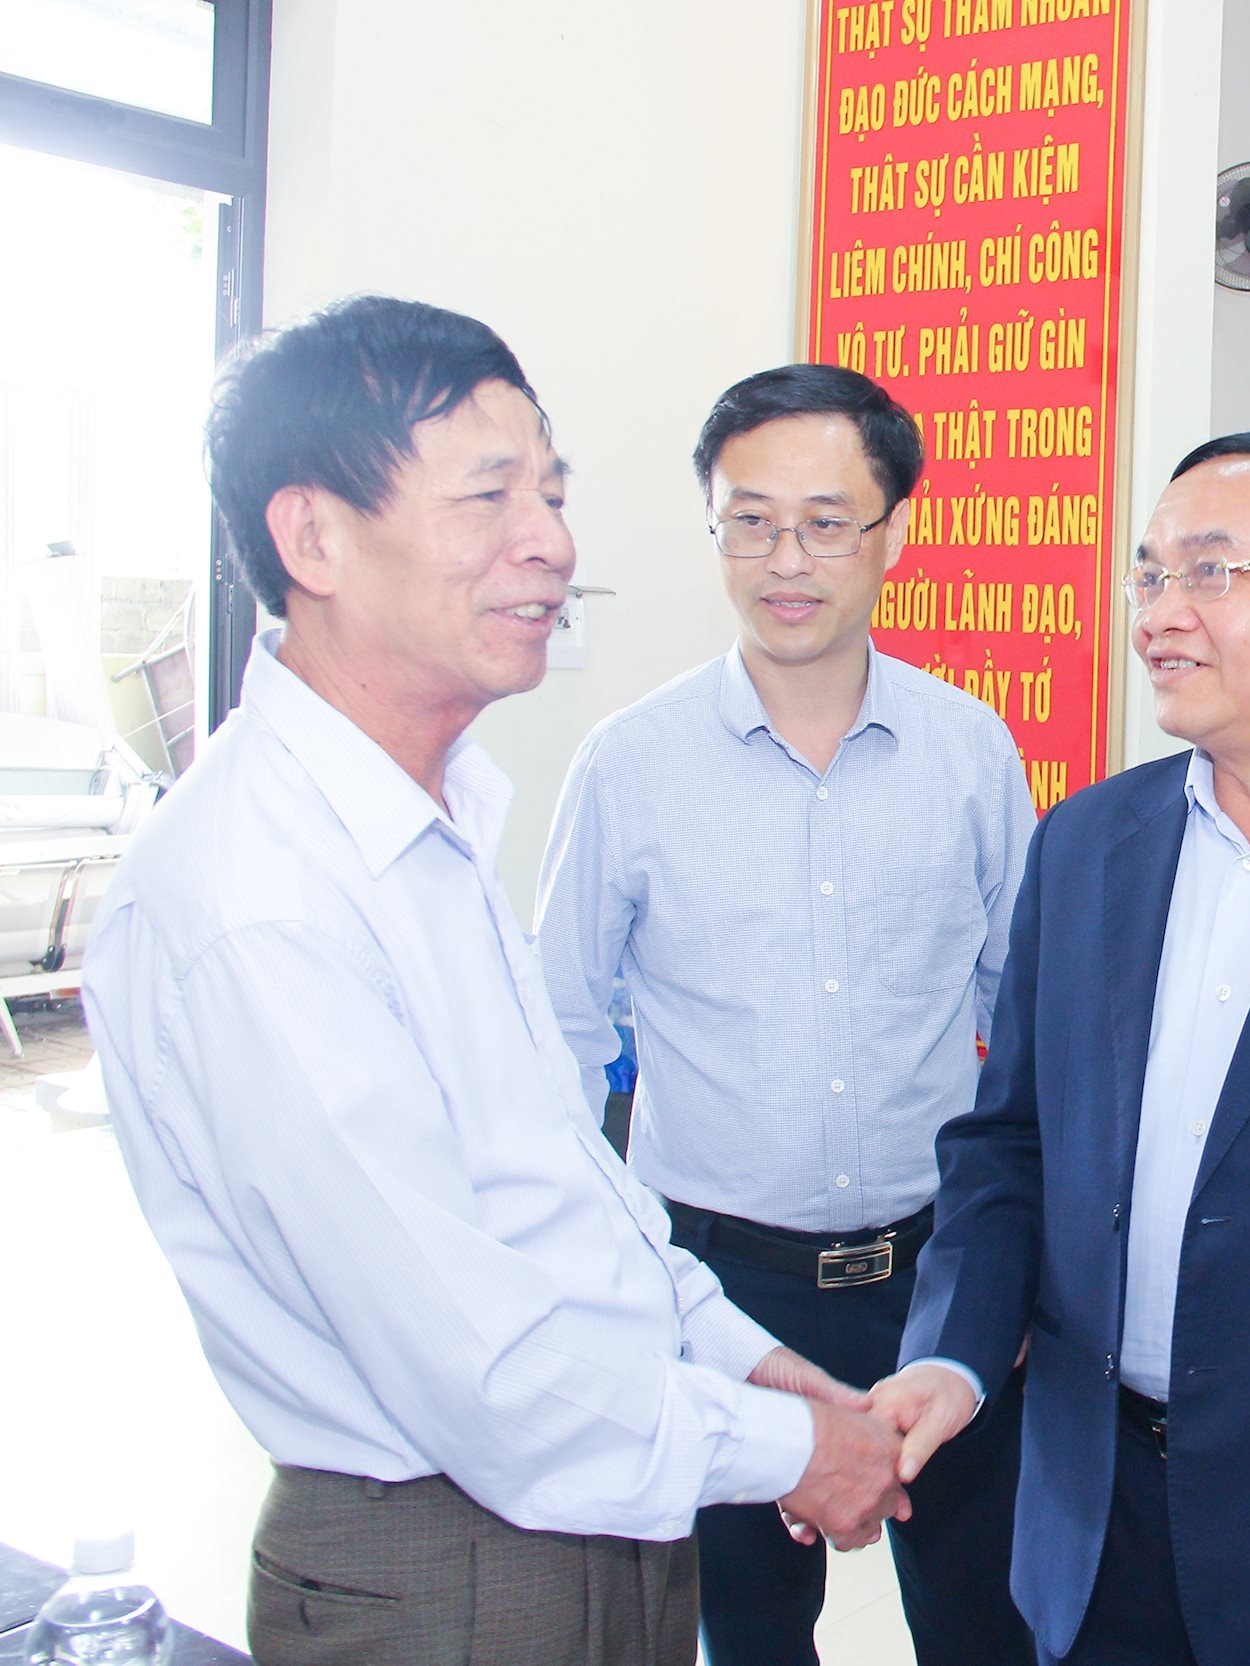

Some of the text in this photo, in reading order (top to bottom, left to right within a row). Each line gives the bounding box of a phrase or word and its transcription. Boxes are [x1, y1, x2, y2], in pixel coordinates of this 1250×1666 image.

[839, 53, 1105, 143] ĐẠO ĐỨC CÁCH MẠNG,
[914, 152, 950, 217] SỰ
[953, 132, 1006, 206] CẦN
[1012, 134, 1081, 206] KIỆM
[830, 220, 1100, 299] LIÊM CHÍNH, CHÍ CÔNG
[873, 324, 910, 378] TƯ.
[918, 306, 980, 376] PHẢI
[988, 308, 1035, 373] GIỮ
[1040, 307, 1087, 370] GÌN
[933, 399, 1094, 470] THẬT TRONG
[949, 482, 1021, 546] XỨNG
[1026, 482, 1098, 546] ĐÁNG
[871, 567, 1083, 644] GƯỜI LÃNH ĐẠO,
[1020, 656, 1053, 724] TỚ
